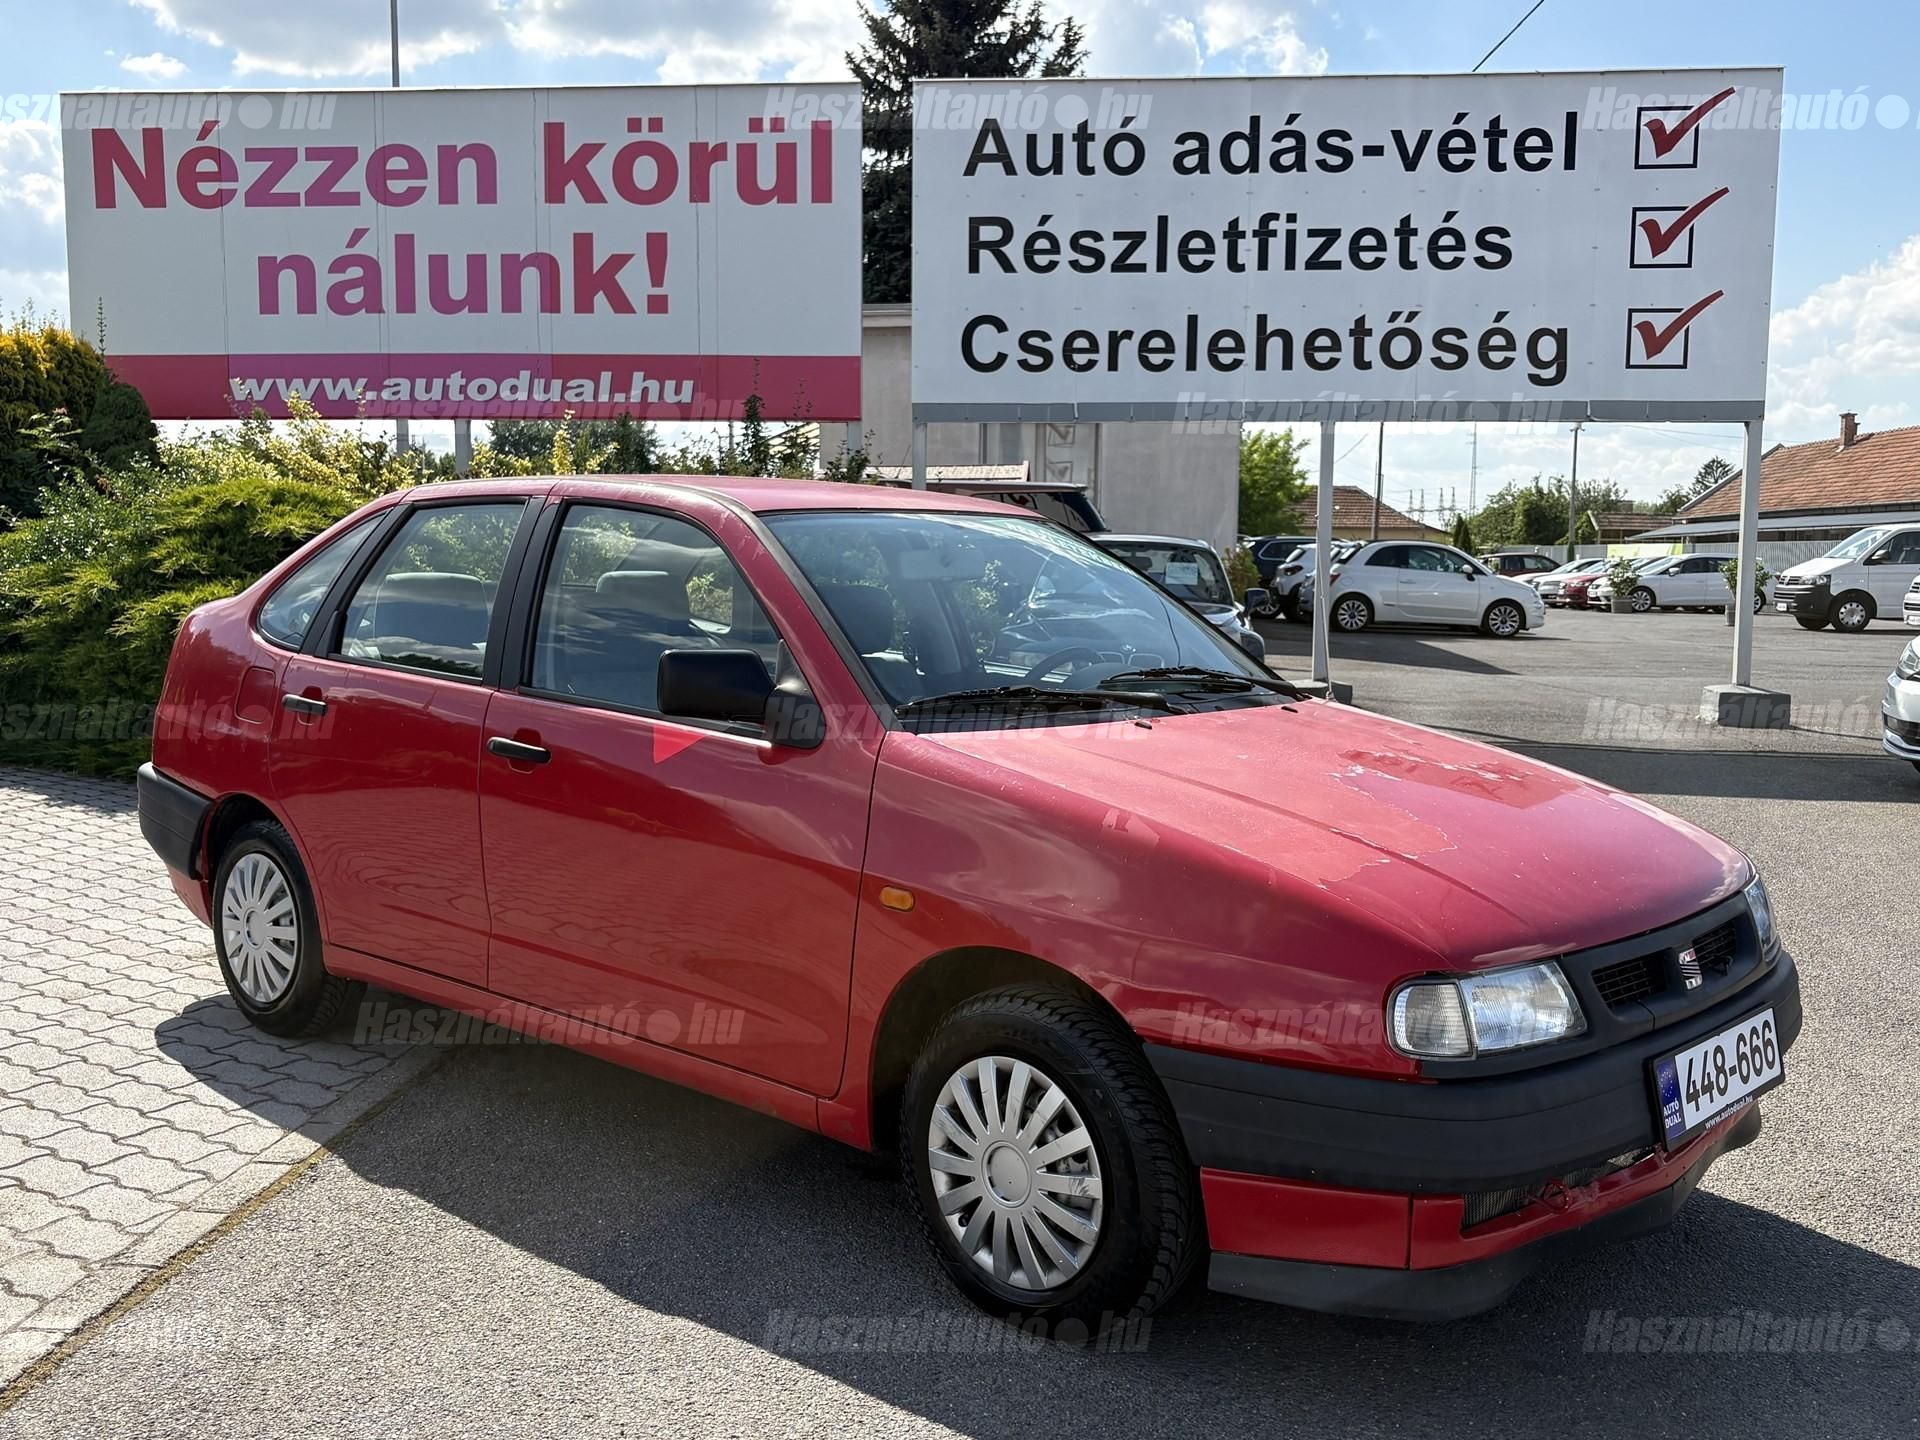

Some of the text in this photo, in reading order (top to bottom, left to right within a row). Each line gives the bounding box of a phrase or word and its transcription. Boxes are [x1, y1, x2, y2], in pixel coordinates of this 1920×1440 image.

[91, 116, 833, 209] Nézzen körül
[962, 111, 1579, 177] Autó adás-vétel
[257, 227, 669, 316] nálunk!
[967, 211, 1513, 275] Részletfizetés
[961, 310, 1568, 388] Cserelehetőség
[229, 370, 695, 404] www.autodual.hu
[1685, 1018, 1776, 1113] 448-666
[1665, 1113, 1682, 1129] DUAL
